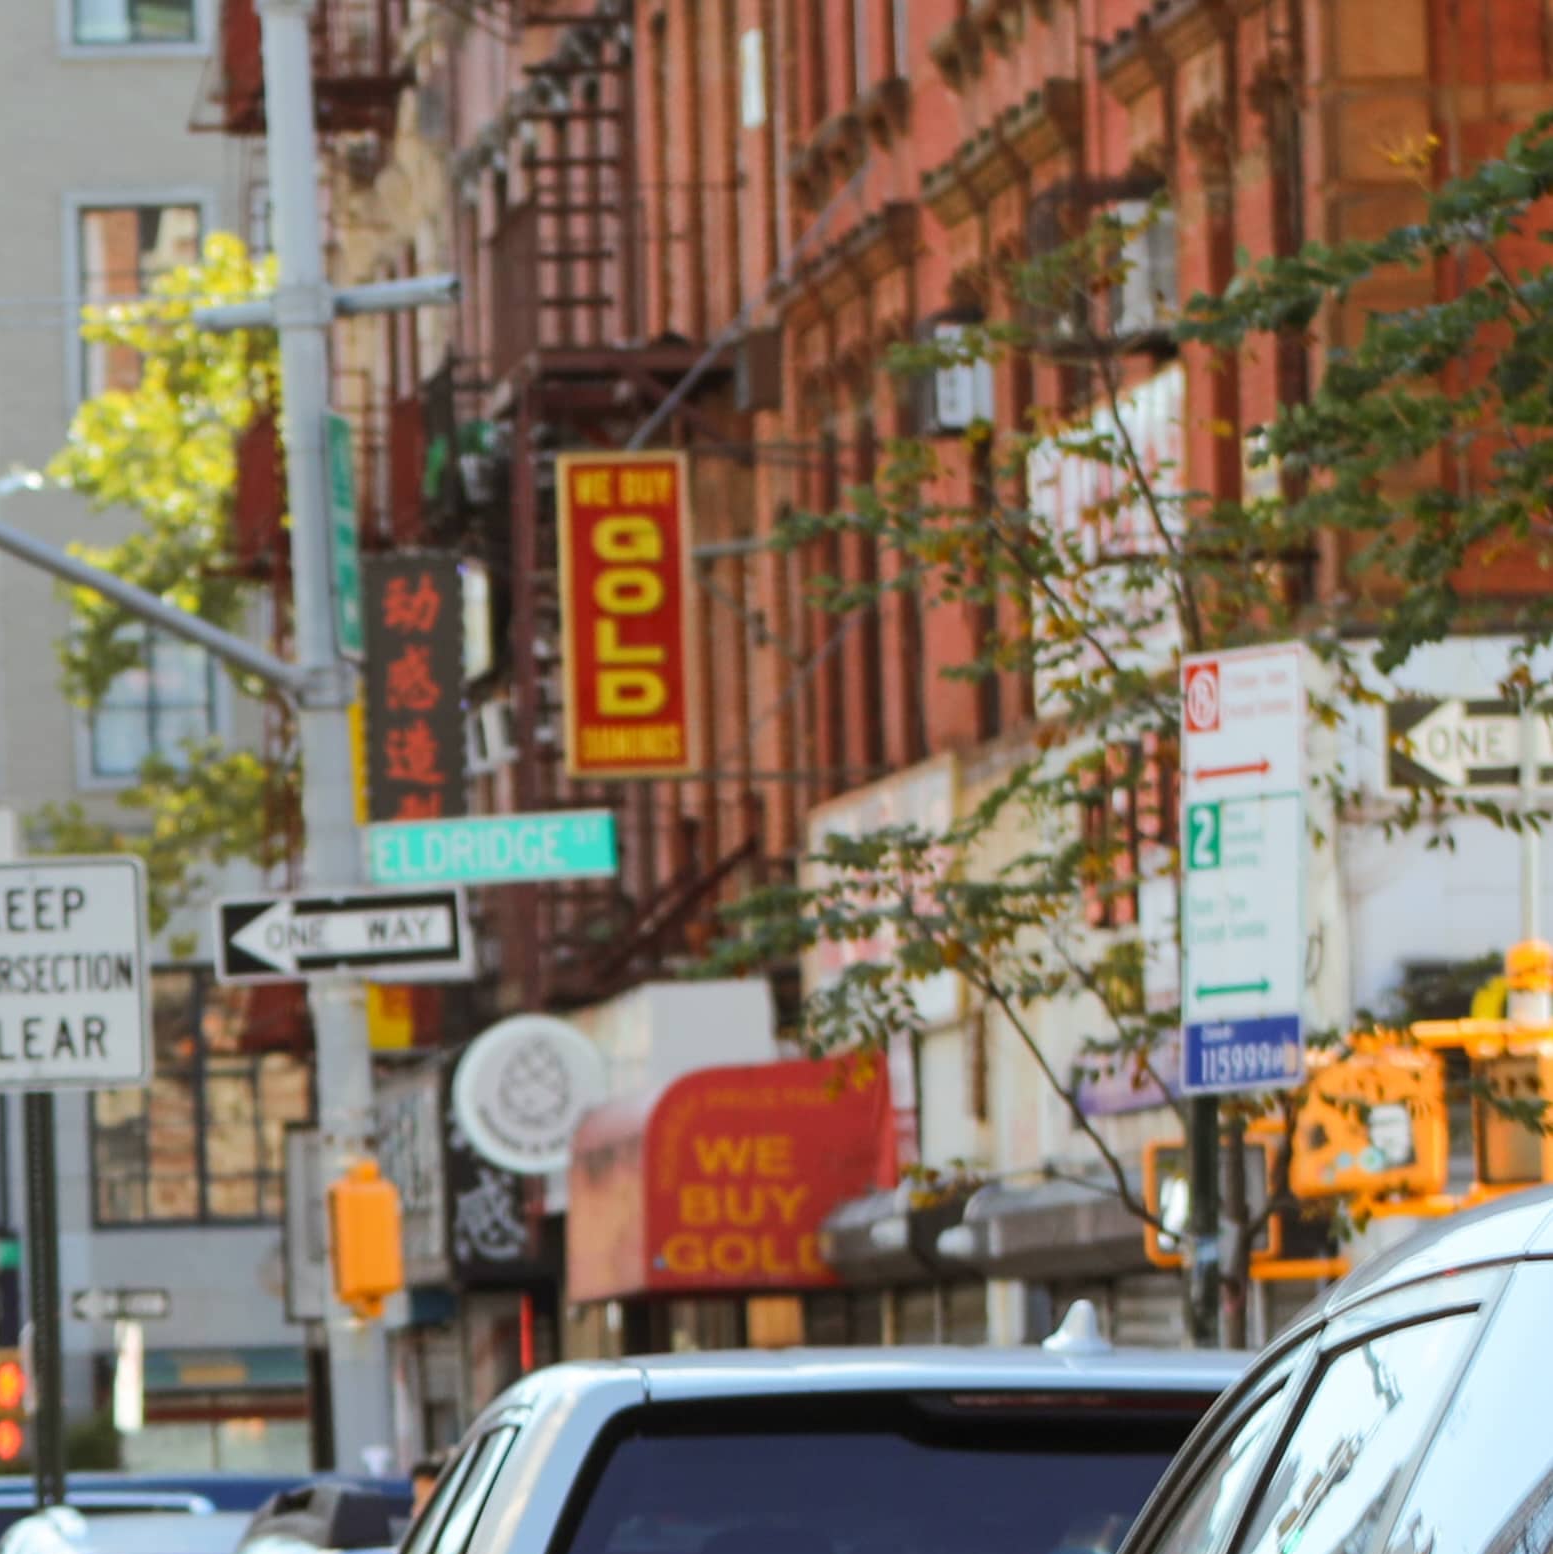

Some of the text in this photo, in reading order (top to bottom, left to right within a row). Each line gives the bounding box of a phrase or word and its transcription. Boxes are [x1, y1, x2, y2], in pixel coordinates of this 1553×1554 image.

[620, 468, 671, 505] BUY
[593, 514, 667, 717] GOLD
[1428, 724, 1506, 762] ONE
[375, 823, 566, 878] ELDRIDGE
[1194, 808, 1215, 865] 2
[264, 915, 434, 950] ONE WAY
[694, 1135, 791, 1176] WE
[679, 1184, 809, 1226] BUY
